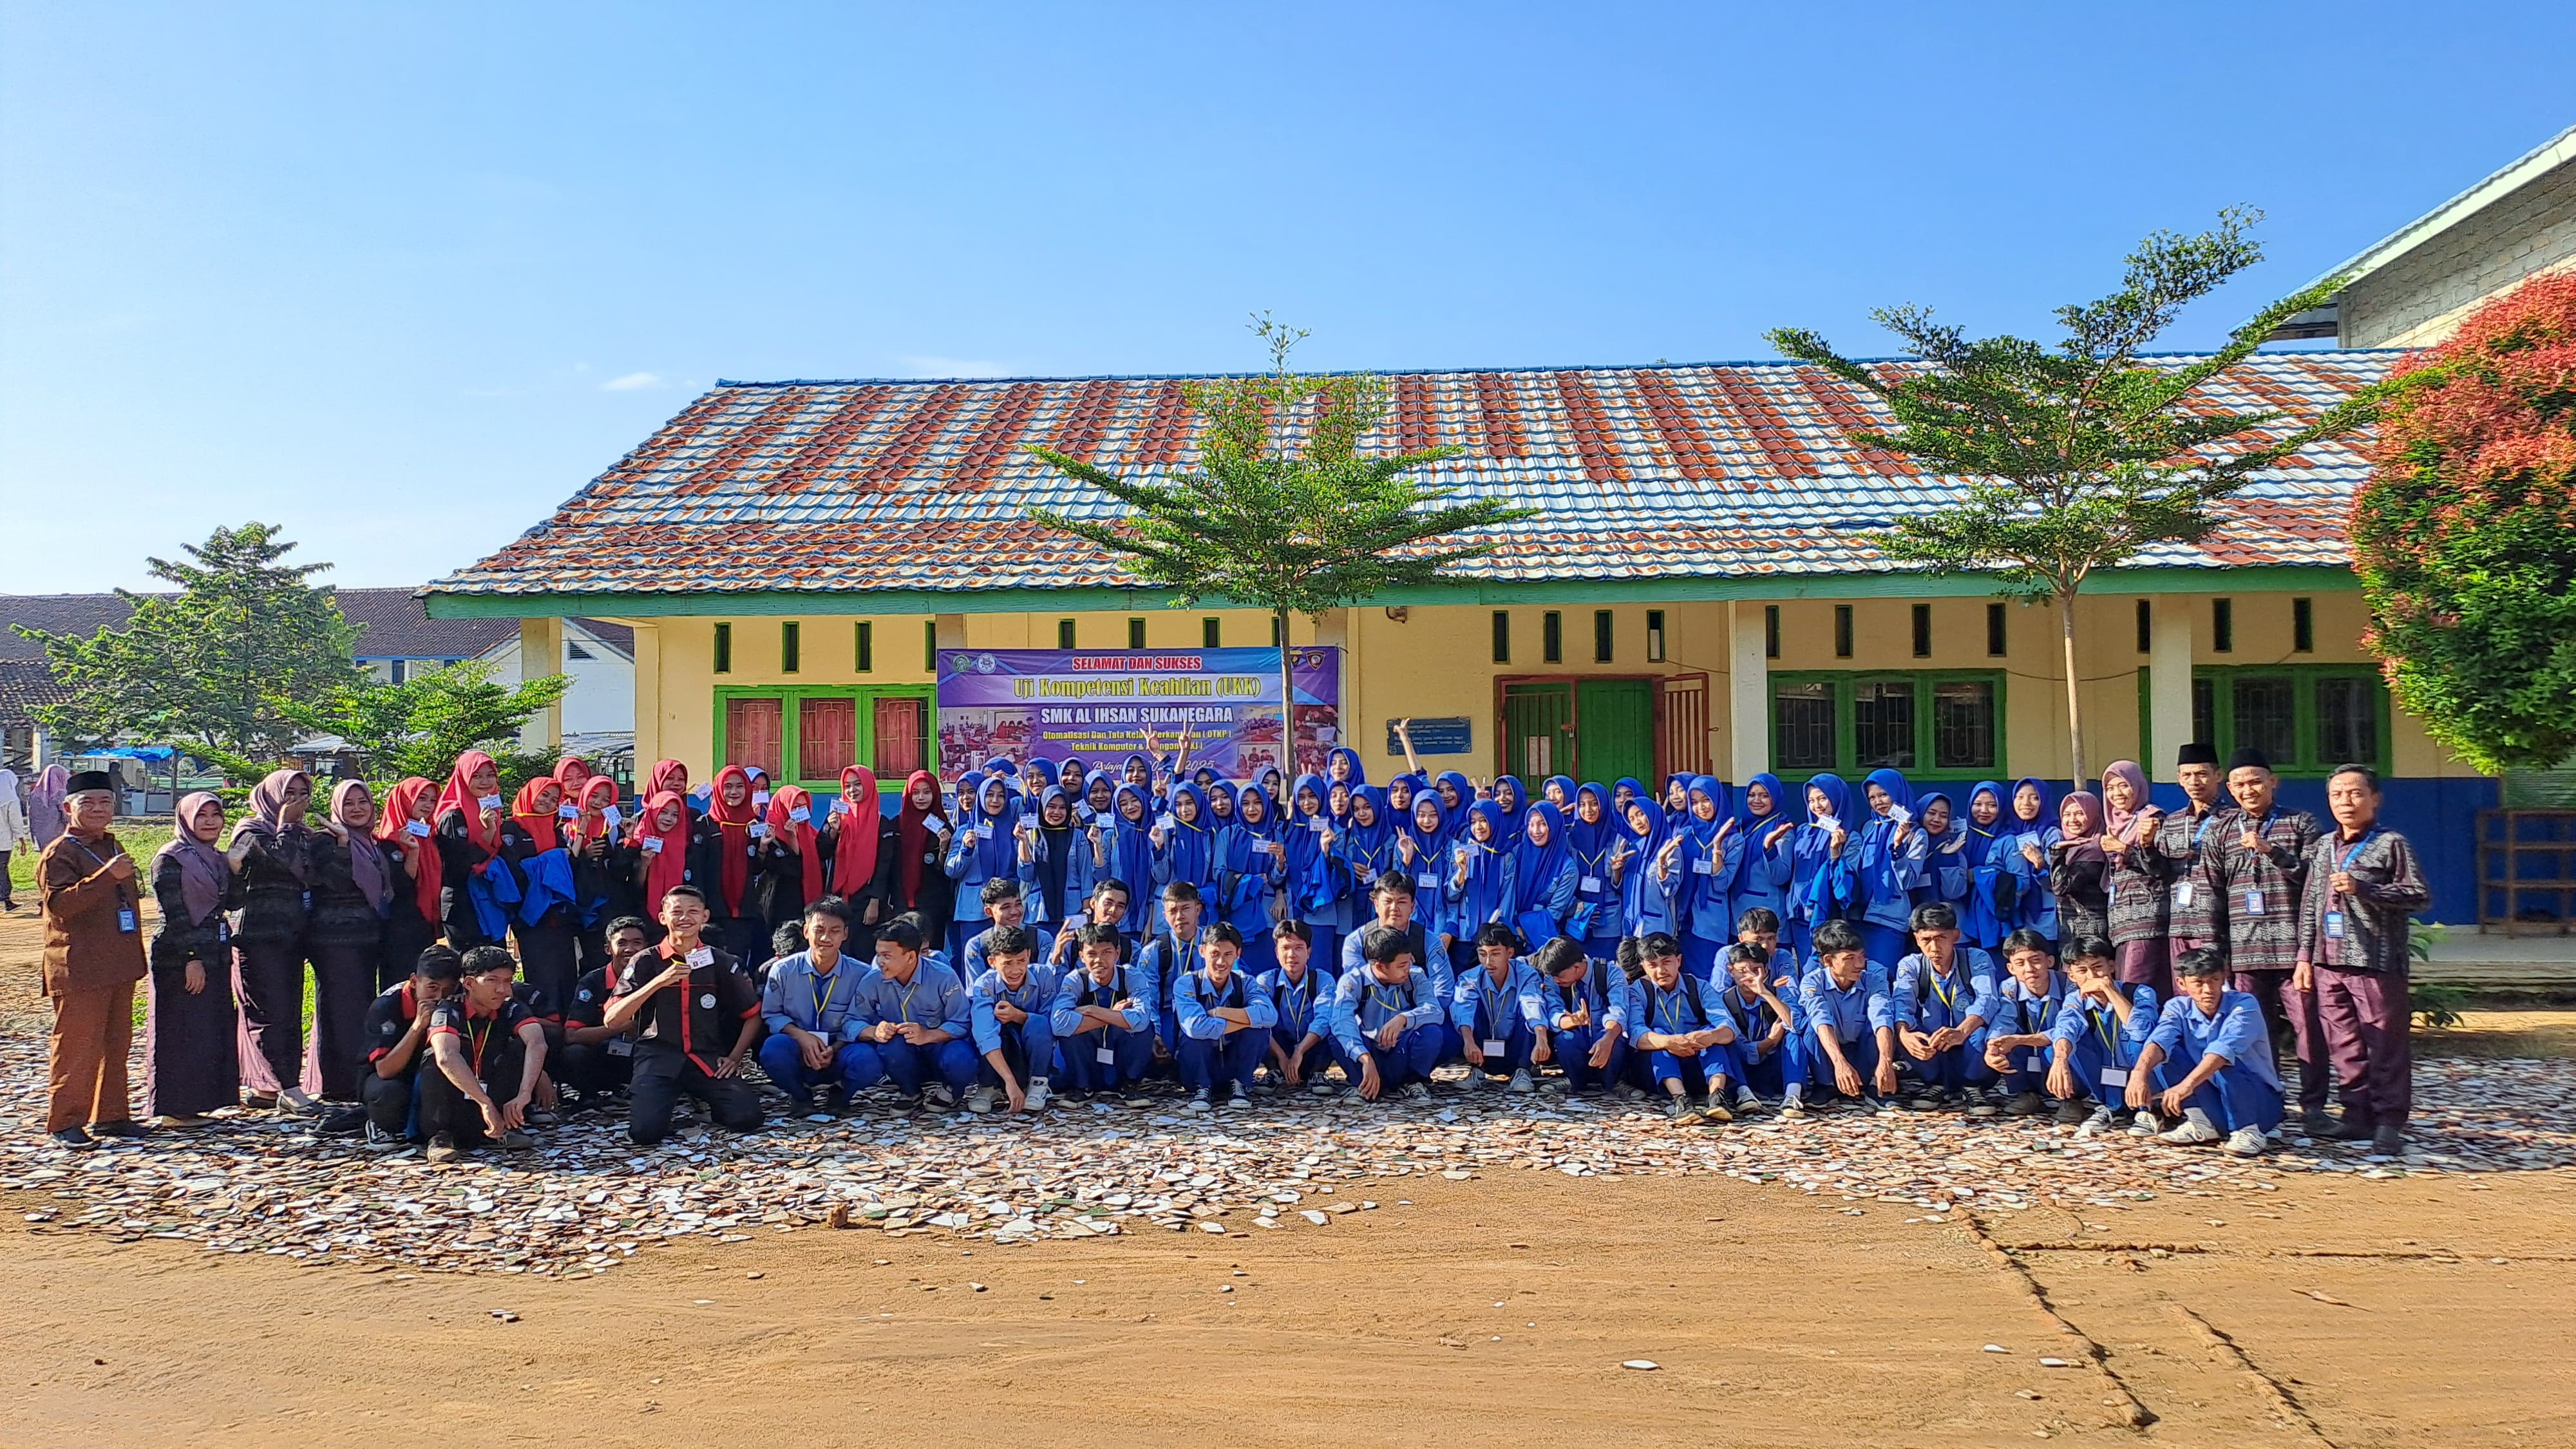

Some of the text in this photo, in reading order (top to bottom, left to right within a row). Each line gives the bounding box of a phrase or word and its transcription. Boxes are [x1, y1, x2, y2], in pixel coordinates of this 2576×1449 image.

[1073, 656, 1202, 670] SELAMAT DAN SUKSES
[1014, 677, 1262, 699] Uji Kompetensi Keahlian (UKK)
[1041, 706, 1234, 724] SMK AL IHSAN SUKANEGARA
[1043, 731, 1090, 740] Otomatisasi
[1091, 731, 1106, 739] Dan
[1108, 730, 1124, 739] Tata
[1207, 730, 1227, 739] OTKP
[1071, 743, 1097, 752] Teknik
[1098, 743, 1137, 752] Komputer
